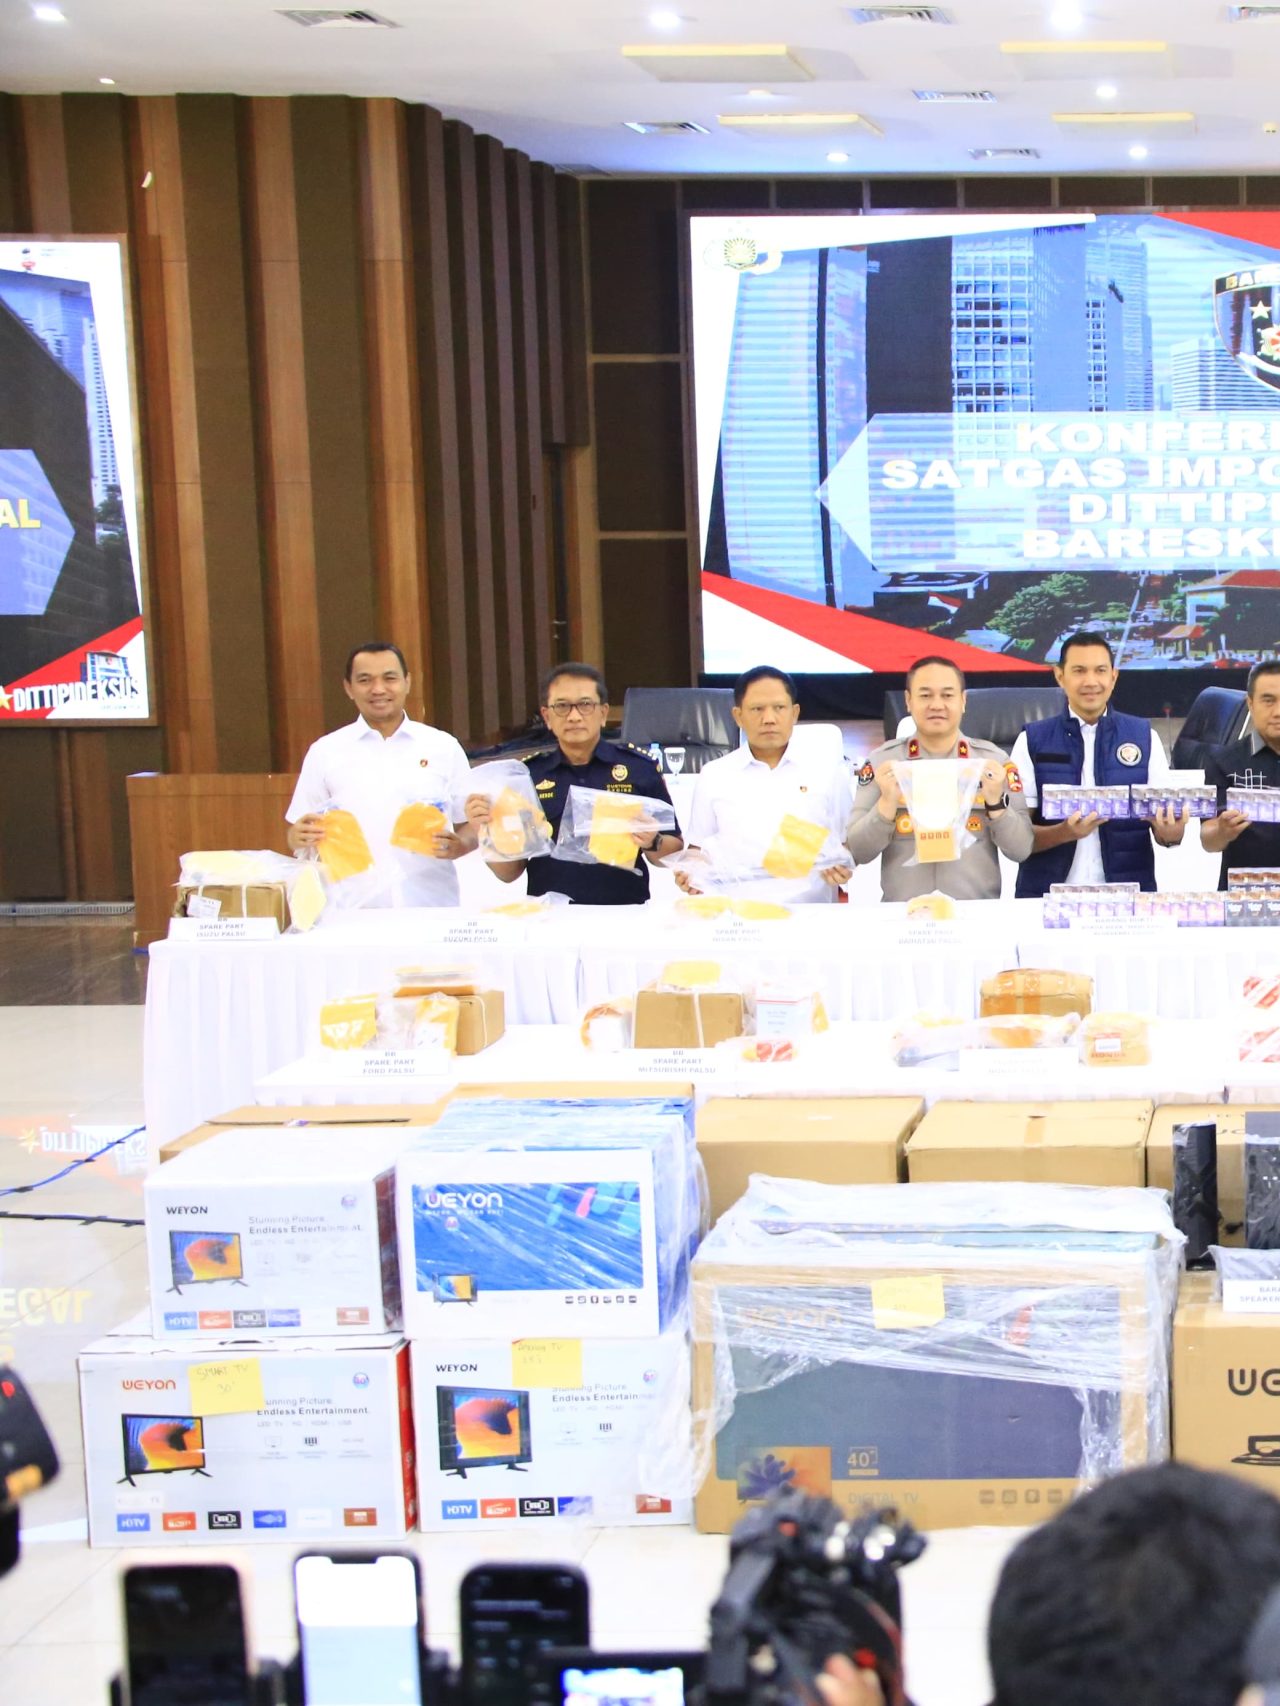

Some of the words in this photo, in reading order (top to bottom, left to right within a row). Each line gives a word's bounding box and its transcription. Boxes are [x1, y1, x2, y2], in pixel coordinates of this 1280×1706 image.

[881, 457, 1127, 490] SATGAS
[13, 676, 140, 713] DITTIPIDEKSUS
[426, 1192, 503, 1208] WEYON
[166, 1206, 209, 1216] WEYON
[249, 1226, 288, 1236] Endless
[1240, 1295, 1280, 1303] SPEAKER
[435, 1363, 478, 1374] WEYON
[121, 1378, 177, 1391] WEYON
[552, 1393, 591, 1404] Endless
[257, 1407, 296, 1417] Endless
[848, 1493, 895, 1505] DIGITAL
[904, 1492, 919, 1504] TV
